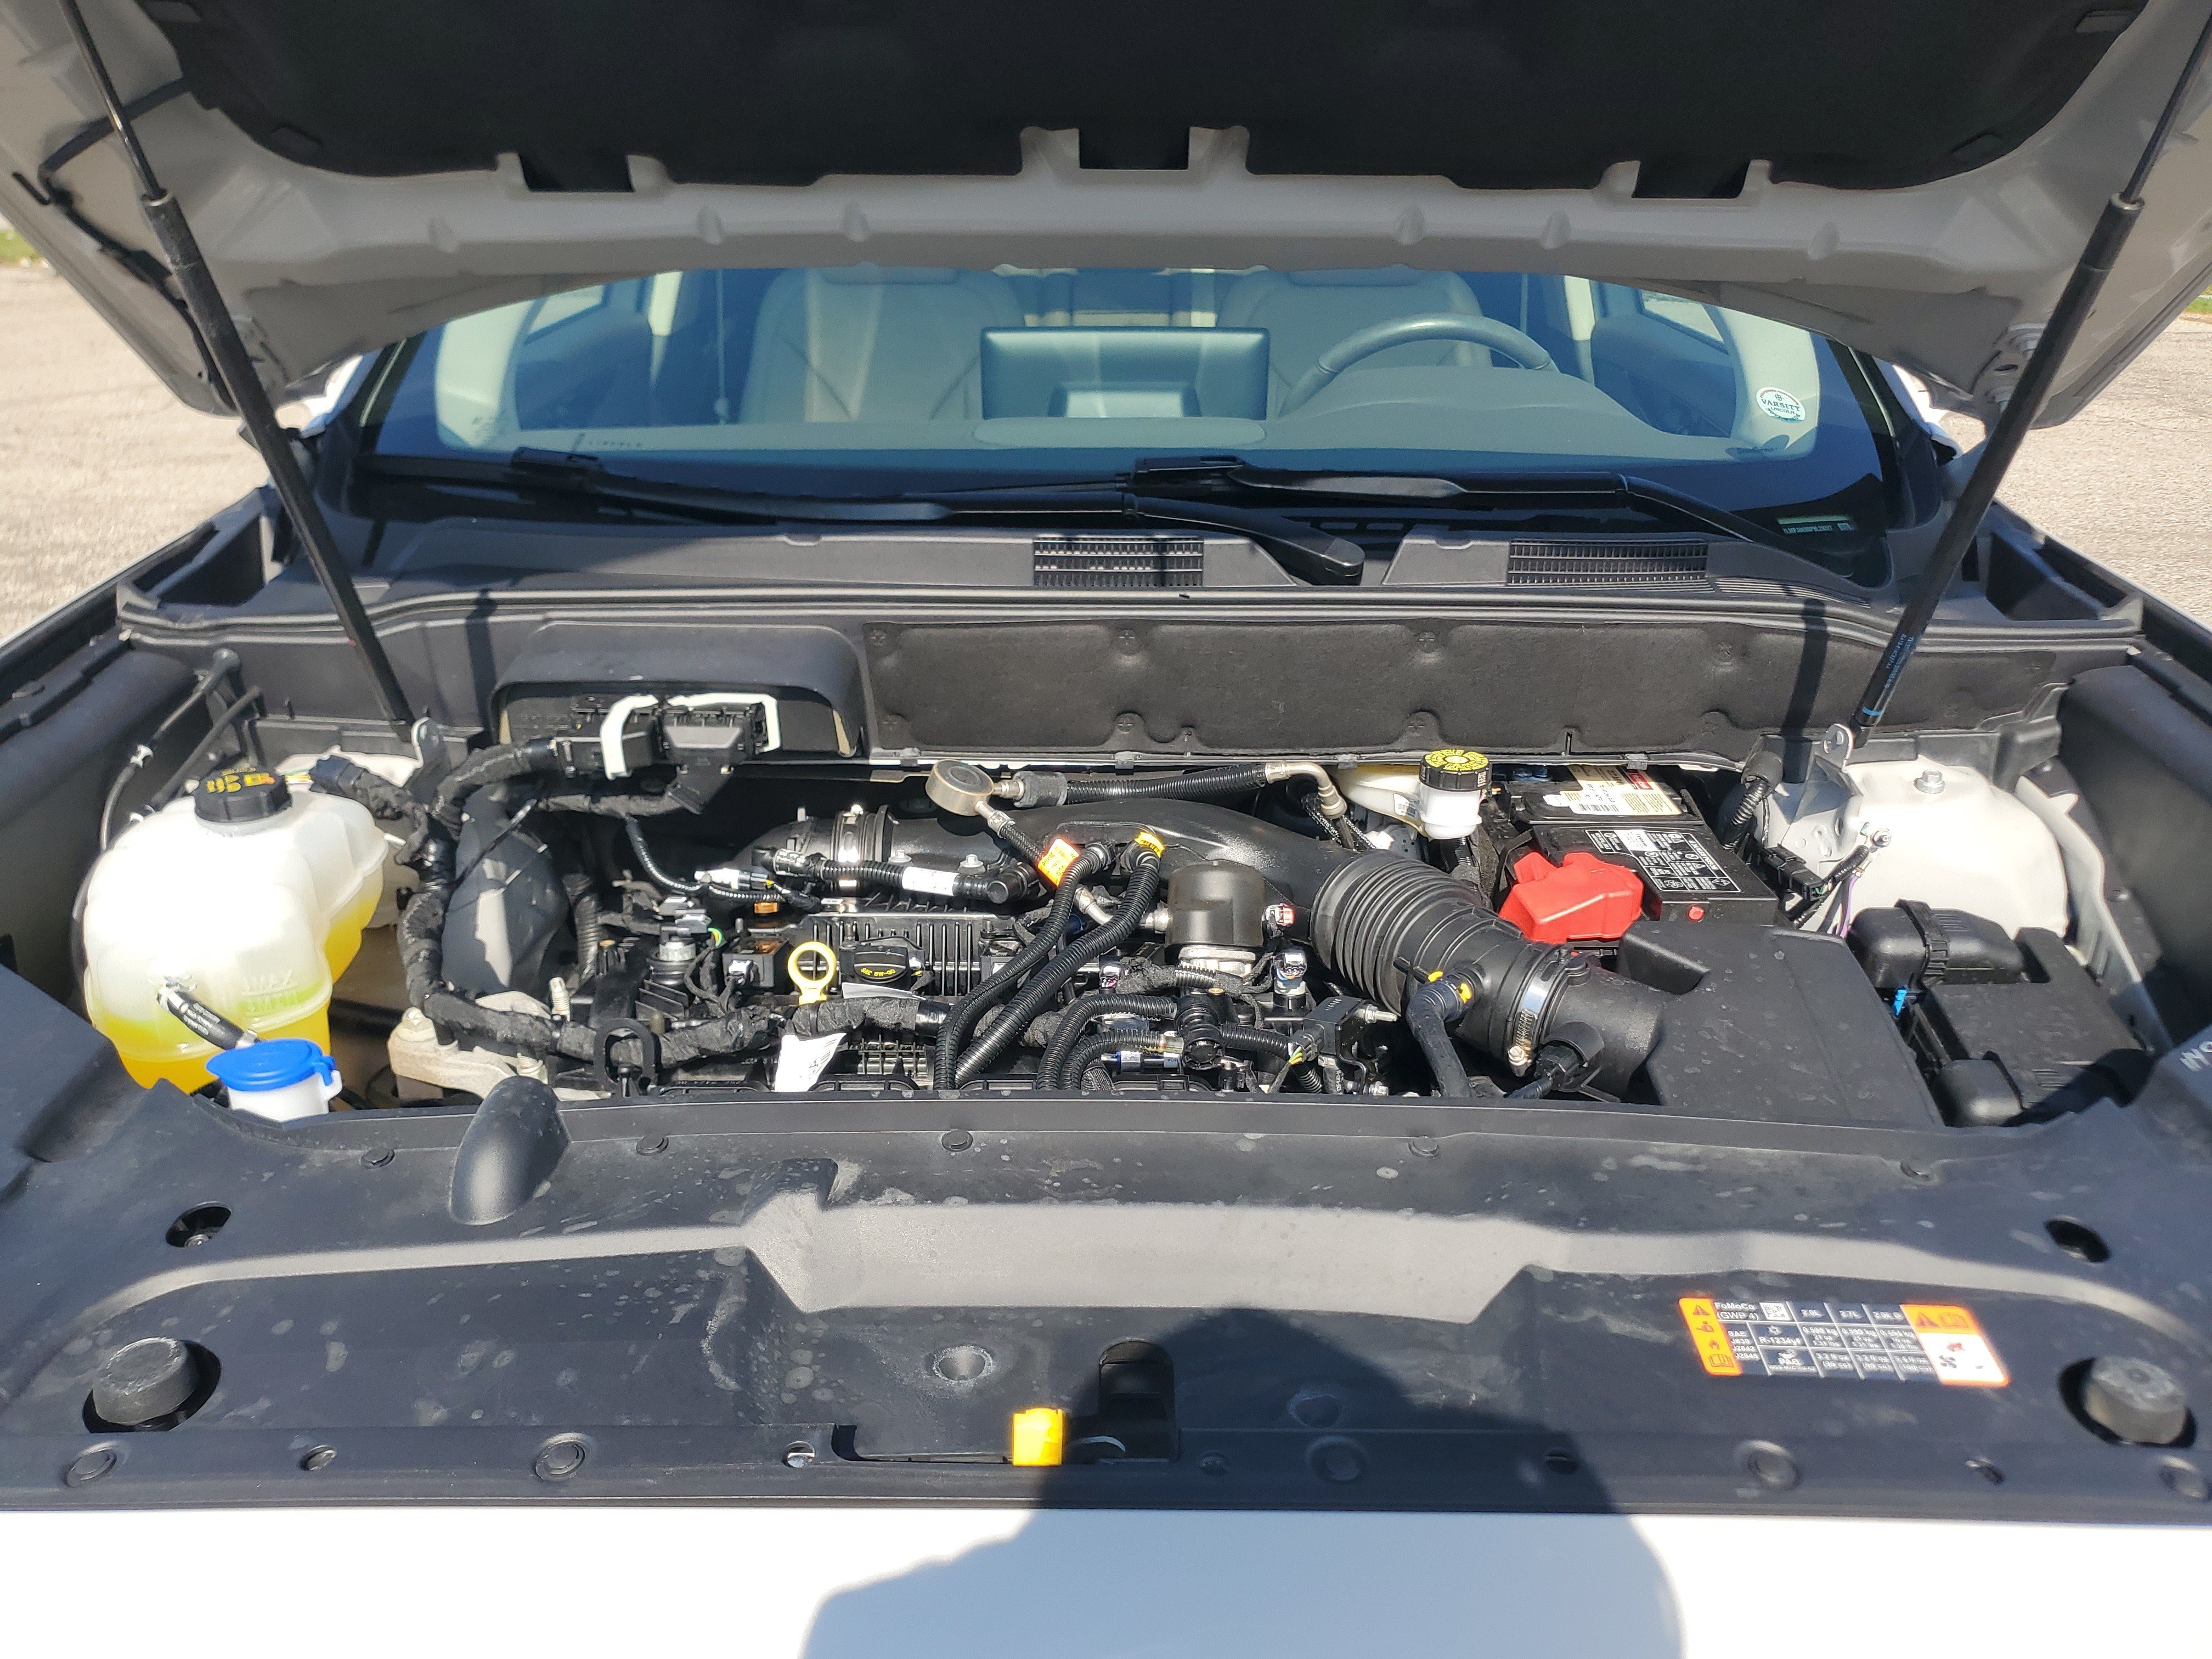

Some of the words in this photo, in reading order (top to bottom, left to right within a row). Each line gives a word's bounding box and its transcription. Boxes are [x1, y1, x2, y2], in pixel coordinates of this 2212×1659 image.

[1761, 399, 1800, 411] VARSITY
[1748, 1312, 1759, 1321] 4)
[1758, 1336, 1800, 1346] R-1234yf
